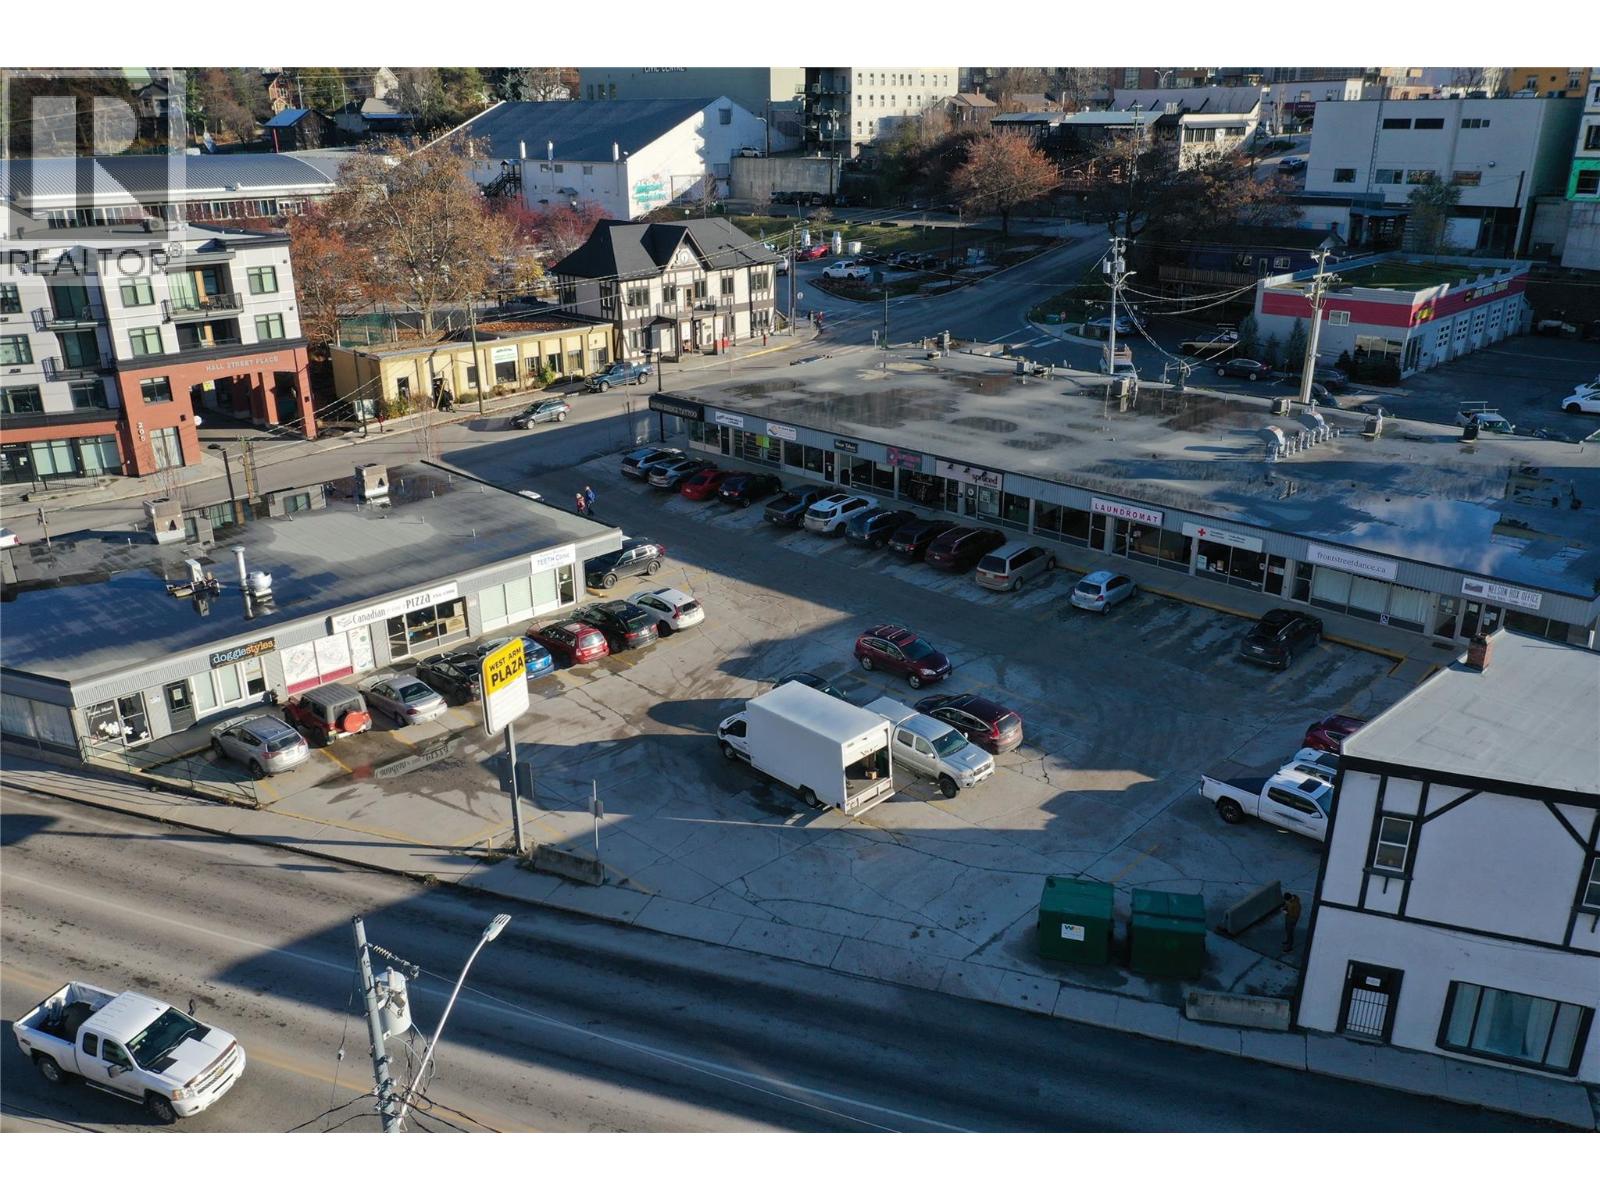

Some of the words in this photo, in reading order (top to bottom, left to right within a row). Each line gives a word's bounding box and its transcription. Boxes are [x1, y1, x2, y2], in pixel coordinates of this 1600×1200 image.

[207, 362, 225, 373] HALL
[227, 359, 253, 369] STREET
[1094, 502, 1159, 523] LAUNDROMAT
[1316, 551, 1387, 574] frontstreetdance.ca
[1488, 583, 1509, 597] NELSON
[1521, 591, 1539, 604] OFFICE
[352, 607, 387, 623] Canadian
[212, 640, 274, 665] doggiestyles
[488, 656, 507, 672] WEST
[508, 647, 522, 661] ARM
[491, 655, 525, 688] PLAZA
